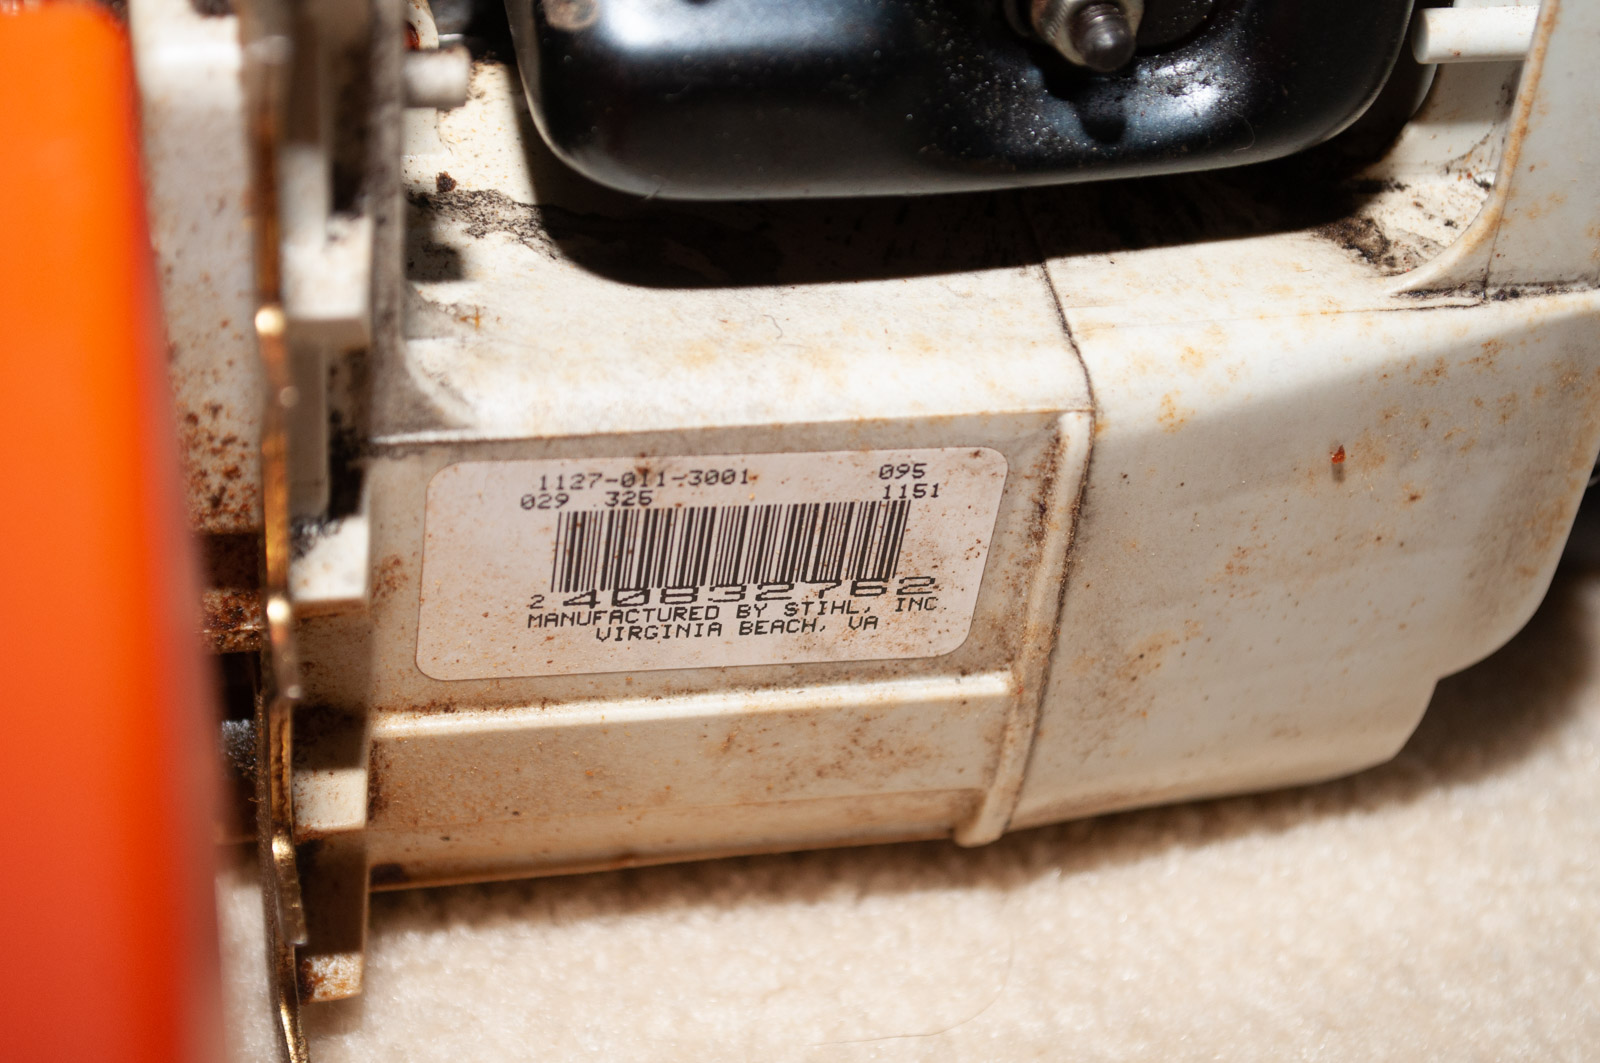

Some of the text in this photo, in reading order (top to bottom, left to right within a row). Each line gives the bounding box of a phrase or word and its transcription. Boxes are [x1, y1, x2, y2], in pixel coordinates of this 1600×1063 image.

[879, 463, 927, 479] 095
[539, 469, 749, 491] 1127-011-3001
[883, 483, 939, 500] 1151
[520, 493, 569, 510] 029
[529, 594, 545, 609] 2
[528, 597, 947, 628] MANUFACTURED BY STIHL, INC.
[596, 616, 879, 642] VIRGINIA BEACH, VA
